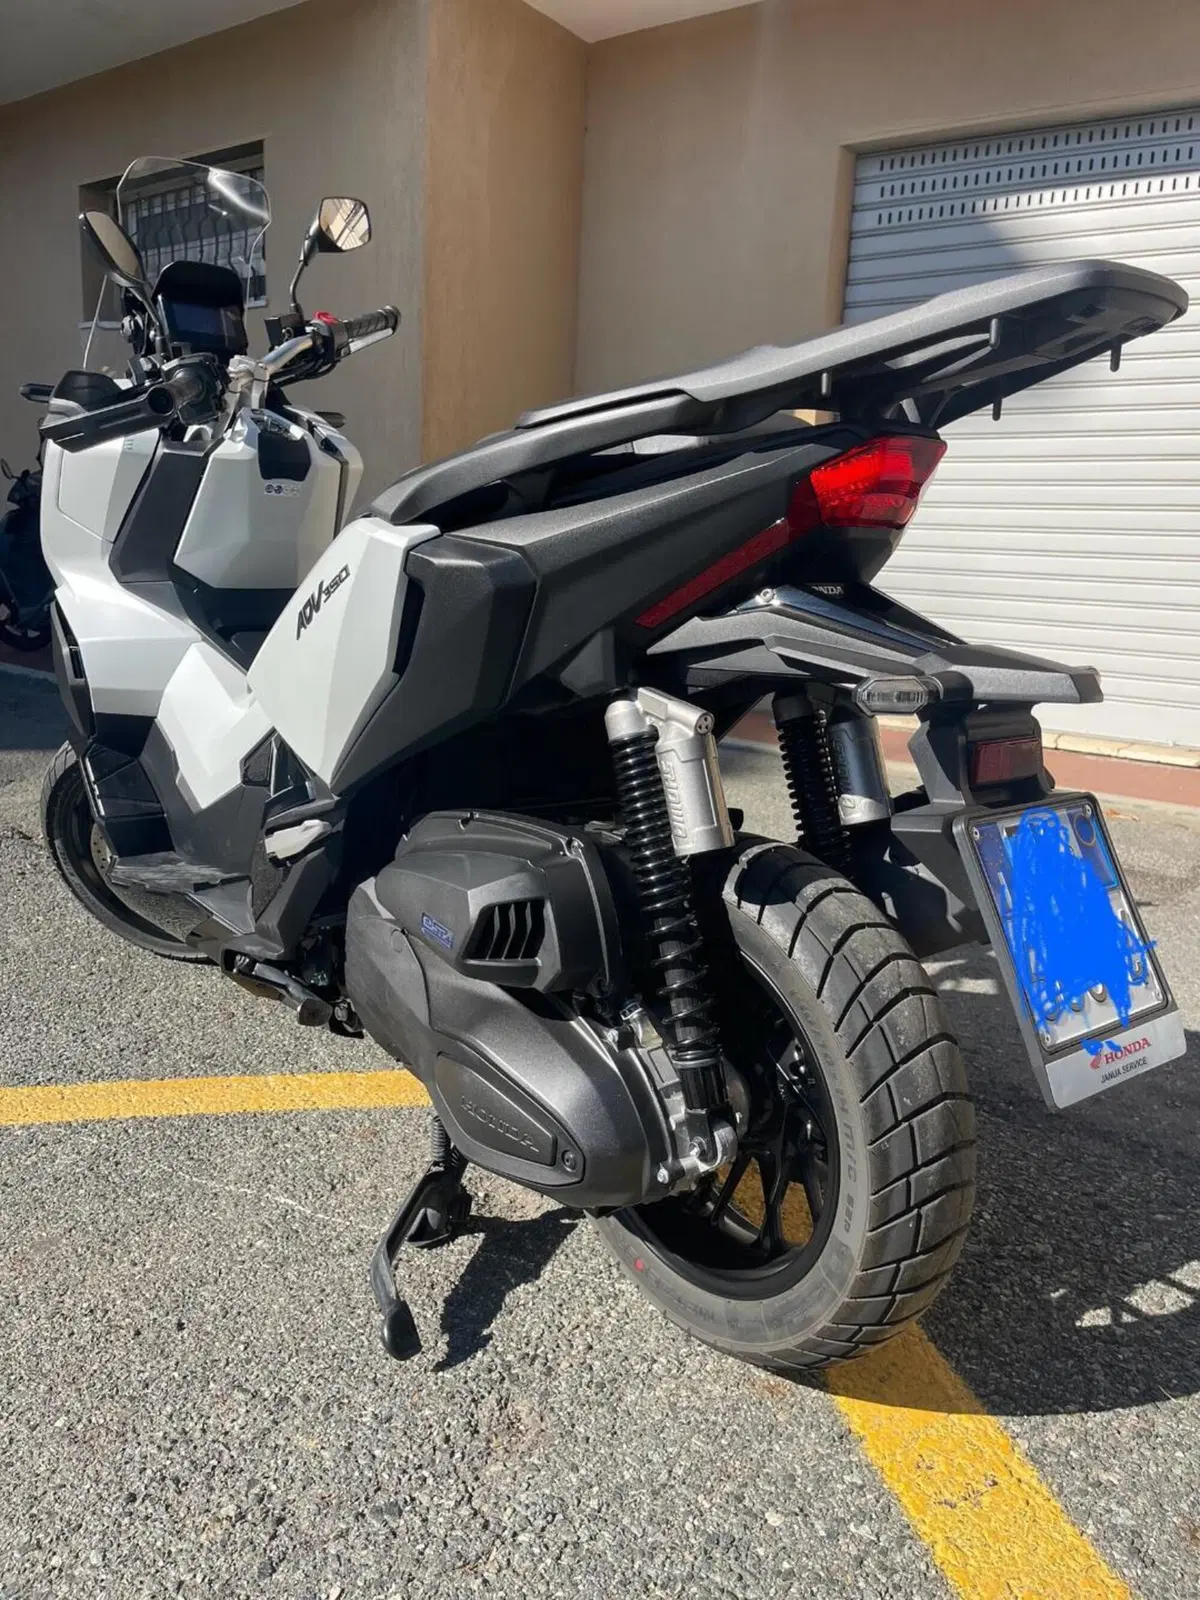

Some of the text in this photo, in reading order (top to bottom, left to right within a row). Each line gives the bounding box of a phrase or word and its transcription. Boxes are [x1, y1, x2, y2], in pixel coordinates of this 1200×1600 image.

[1104, 1038, 1152, 1064] HONDA
[1101, 1056, 1147, 1083] JANUA SERVICE
[461, 1095, 539, 1152] HONDA
